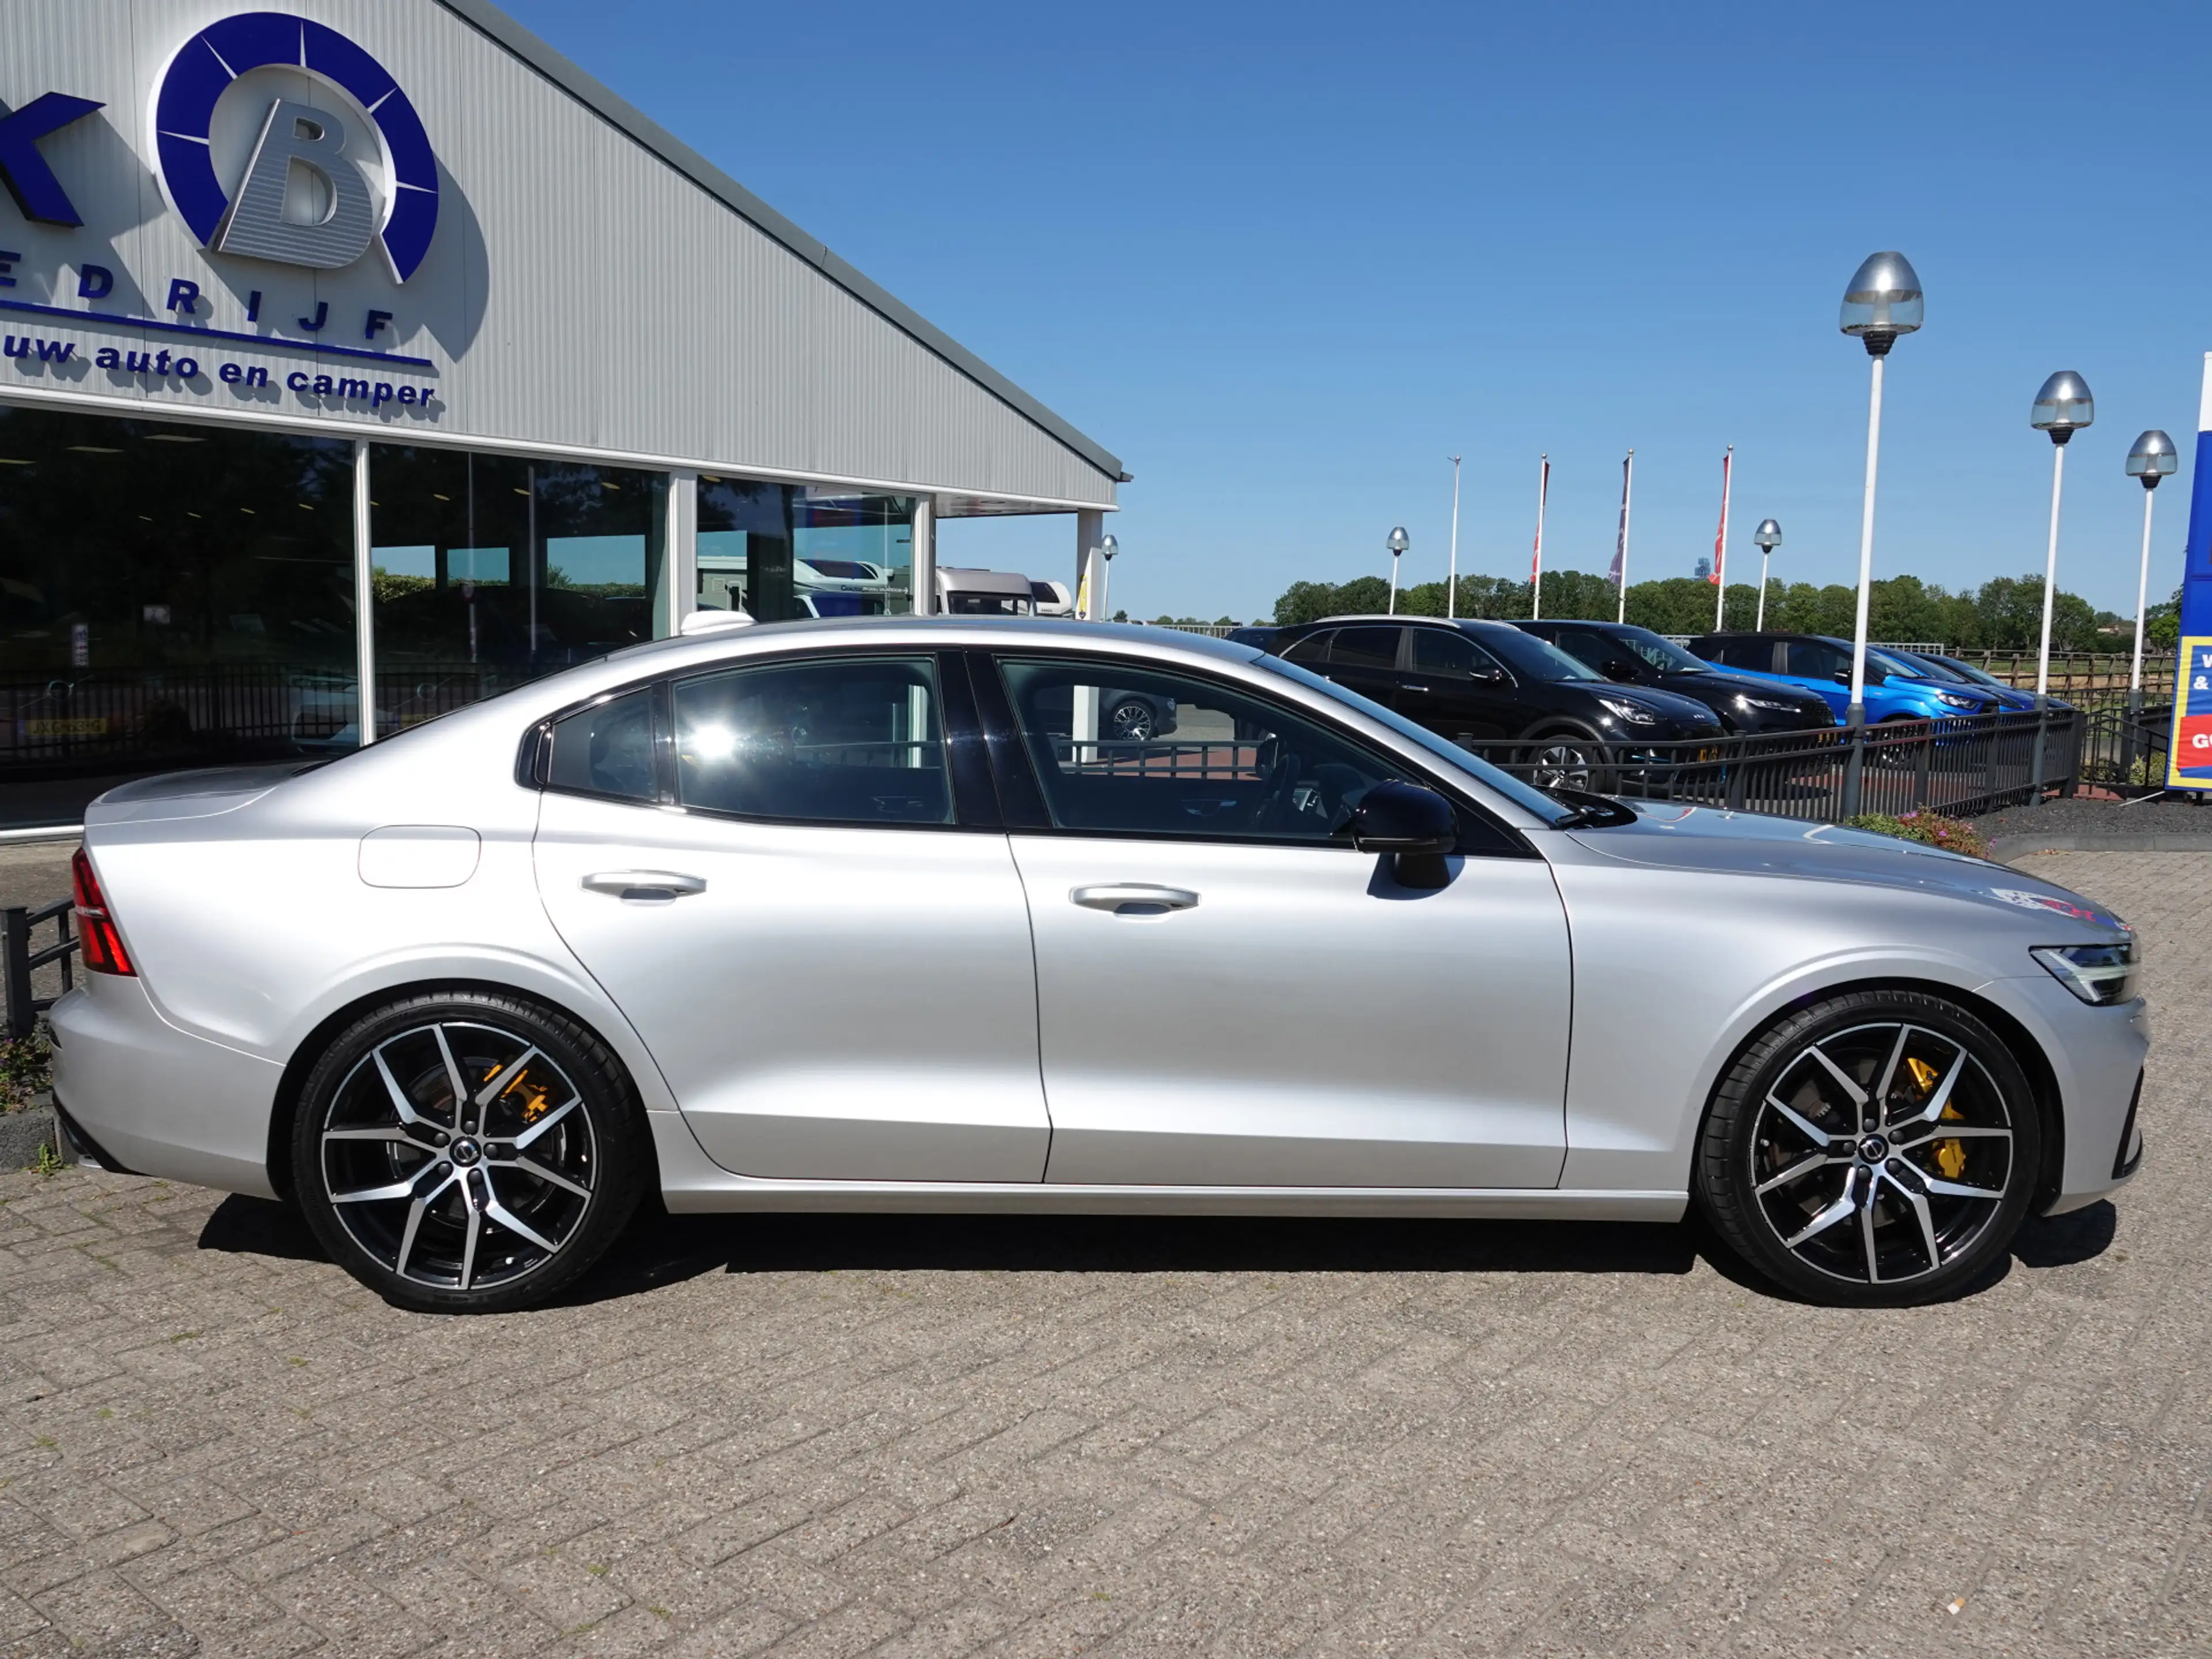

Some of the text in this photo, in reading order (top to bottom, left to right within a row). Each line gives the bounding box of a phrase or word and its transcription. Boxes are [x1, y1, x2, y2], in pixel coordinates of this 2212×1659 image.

[3, 335, 435, 407] uw auto en camper
[2192, 733, 2212, 748] G
